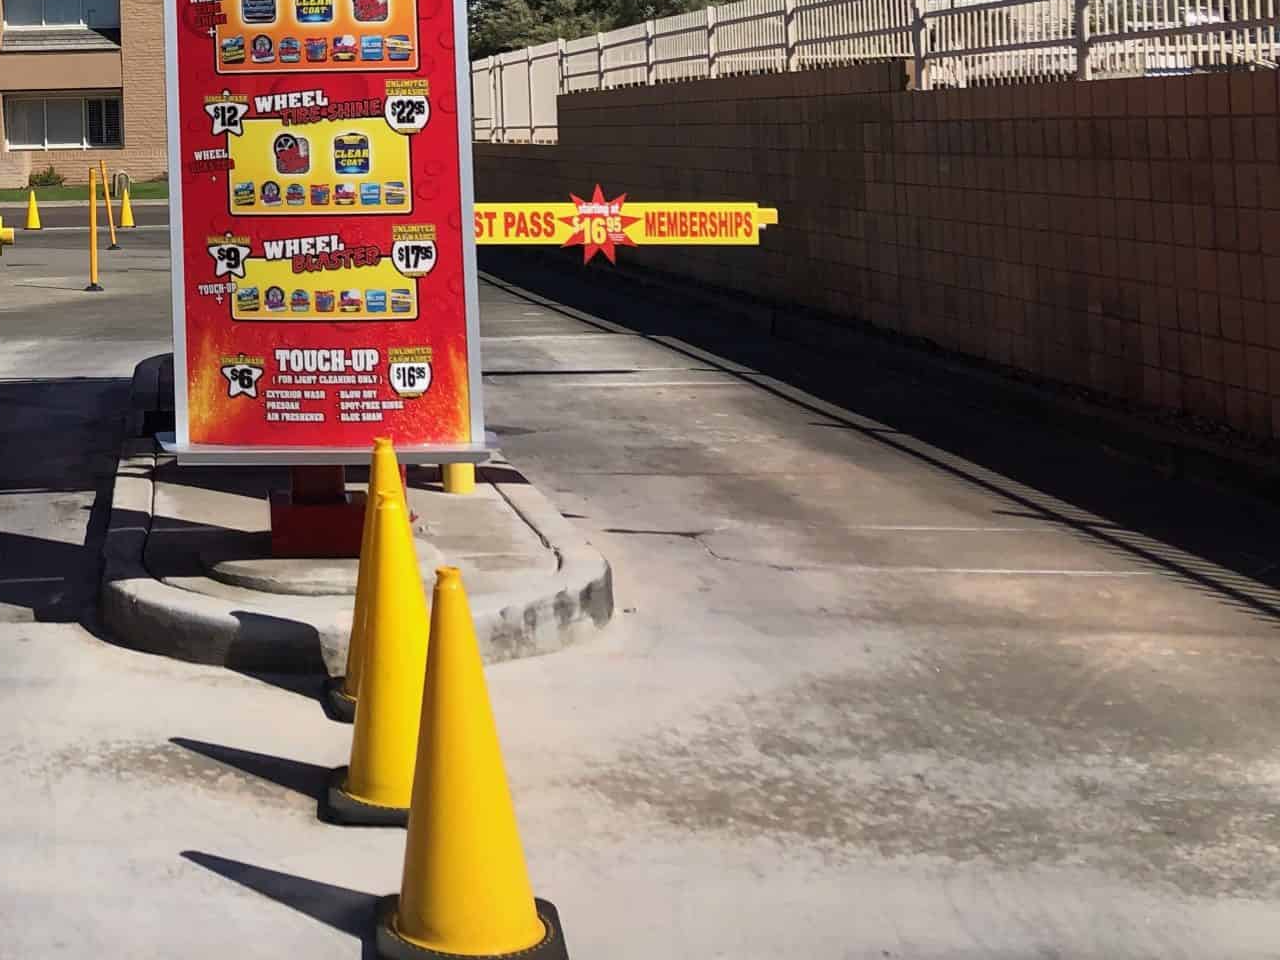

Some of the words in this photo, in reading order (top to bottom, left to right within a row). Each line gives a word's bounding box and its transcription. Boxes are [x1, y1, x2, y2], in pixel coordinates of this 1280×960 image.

[303, 6, 327, 14] COAT
[254, 90, 329, 114] WHEEL
[214, 106, 239, 127] $12
[194, 149, 228, 161] WHEEL
[504, 211, 555, 238] PASS
[645, 211, 753, 237] MEMBERSHIPS
[218, 247, 241, 269] $9
[263, 235, 344, 259] WHEEL
[291, 246, 382, 274] BLASTER
[275, 348, 379, 372] TOUCH-UP
[230, 368, 254, 389] $6
